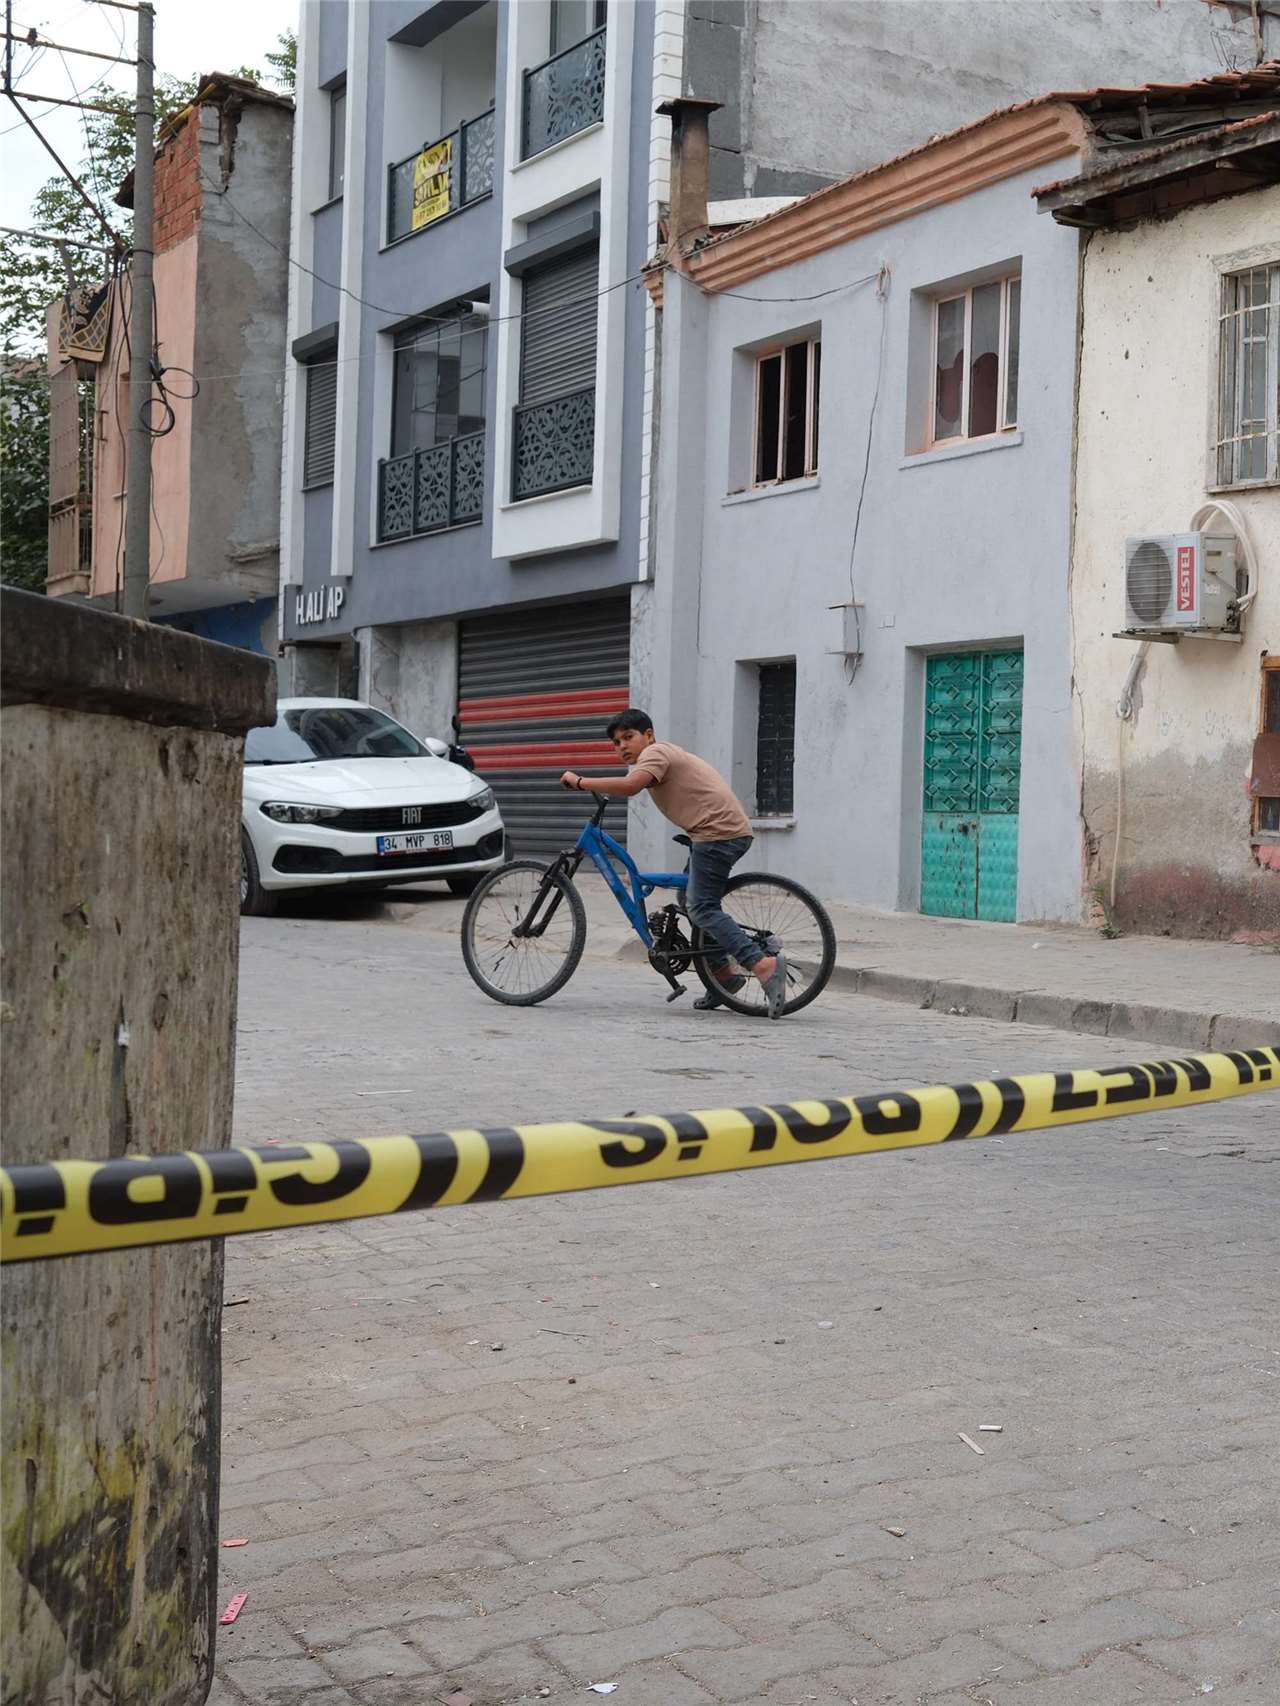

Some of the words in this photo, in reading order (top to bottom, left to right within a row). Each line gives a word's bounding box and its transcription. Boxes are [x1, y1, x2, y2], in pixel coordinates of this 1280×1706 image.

[1181, 548, 1190, 609] VESTEL
[326, 586, 344, 619] AP
[402, 807, 422, 824] FIAT
[385, 838, 397, 850] 34
[405, 836, 424, 848] MVP
[433, 833, 450, 846] 818
